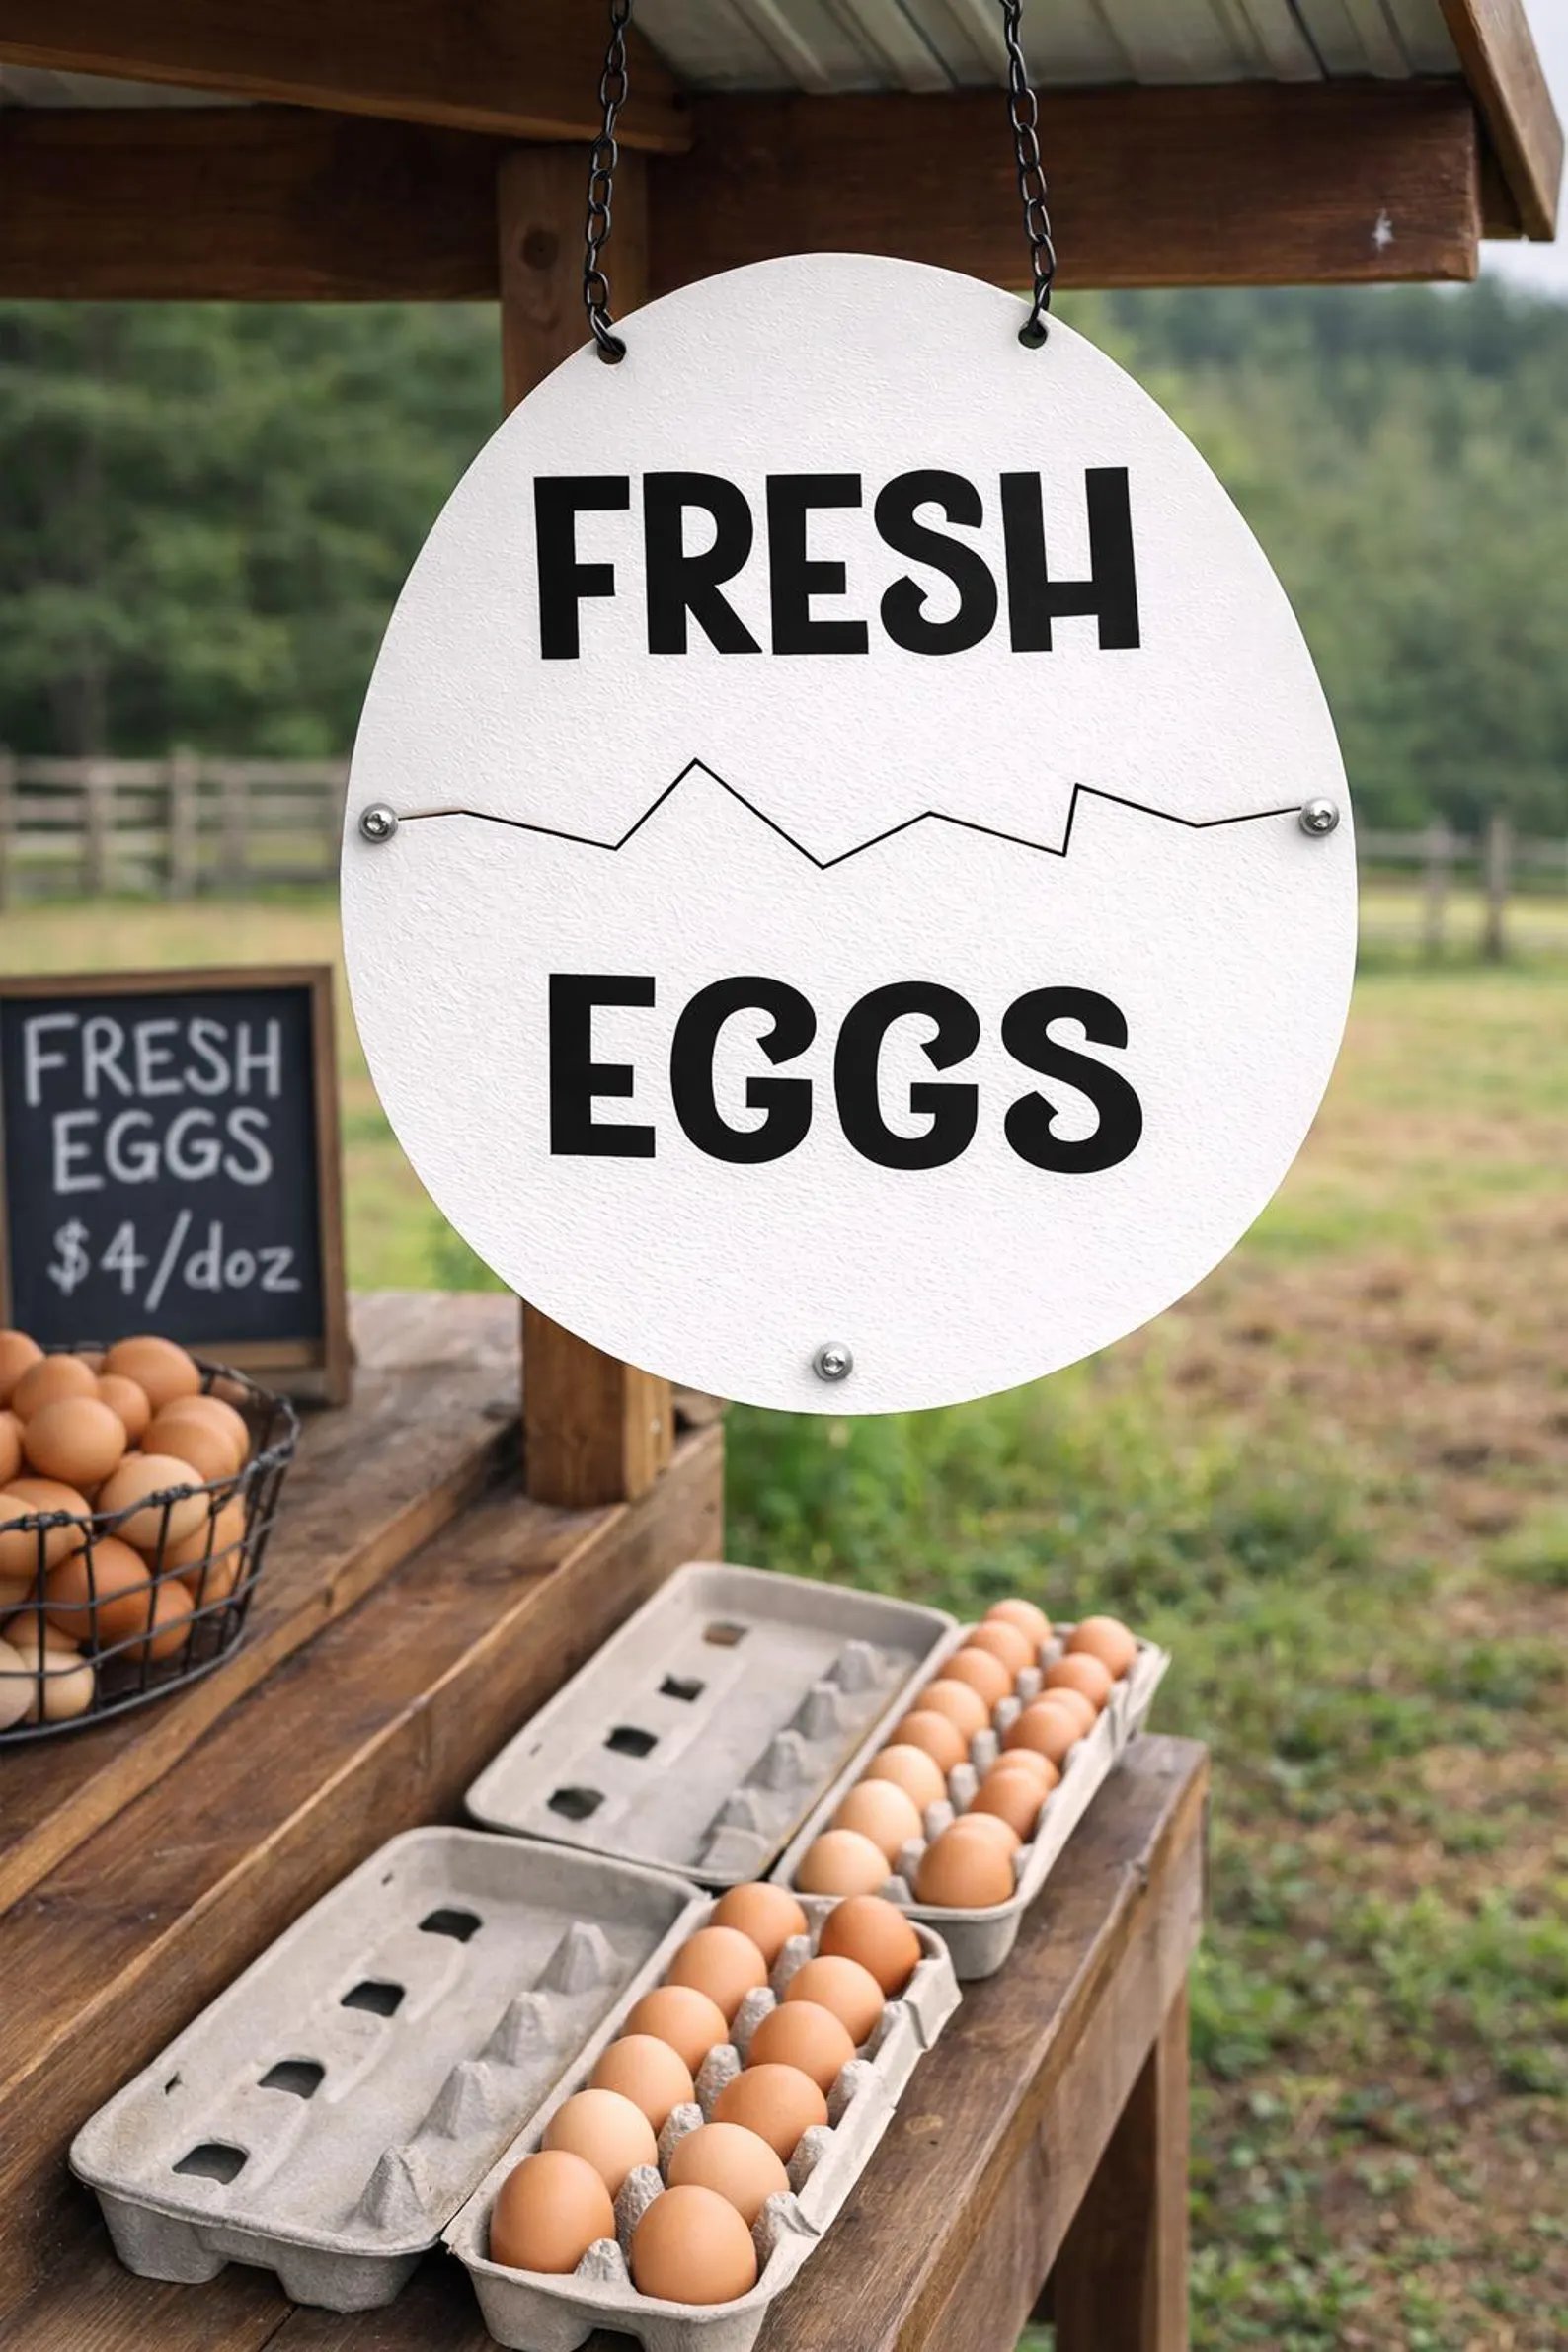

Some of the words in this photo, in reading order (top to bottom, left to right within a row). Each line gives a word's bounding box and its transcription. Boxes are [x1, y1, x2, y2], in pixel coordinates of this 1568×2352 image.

[533, 466, 1141, 660] FRESH
[23, 1013, 281, 1106] FRESH
[548, 973, 1143, 1175] EGGS
[52, 1107, 273, 1194] EGGS
[47, 1210, 301, 1311] $4/doz
